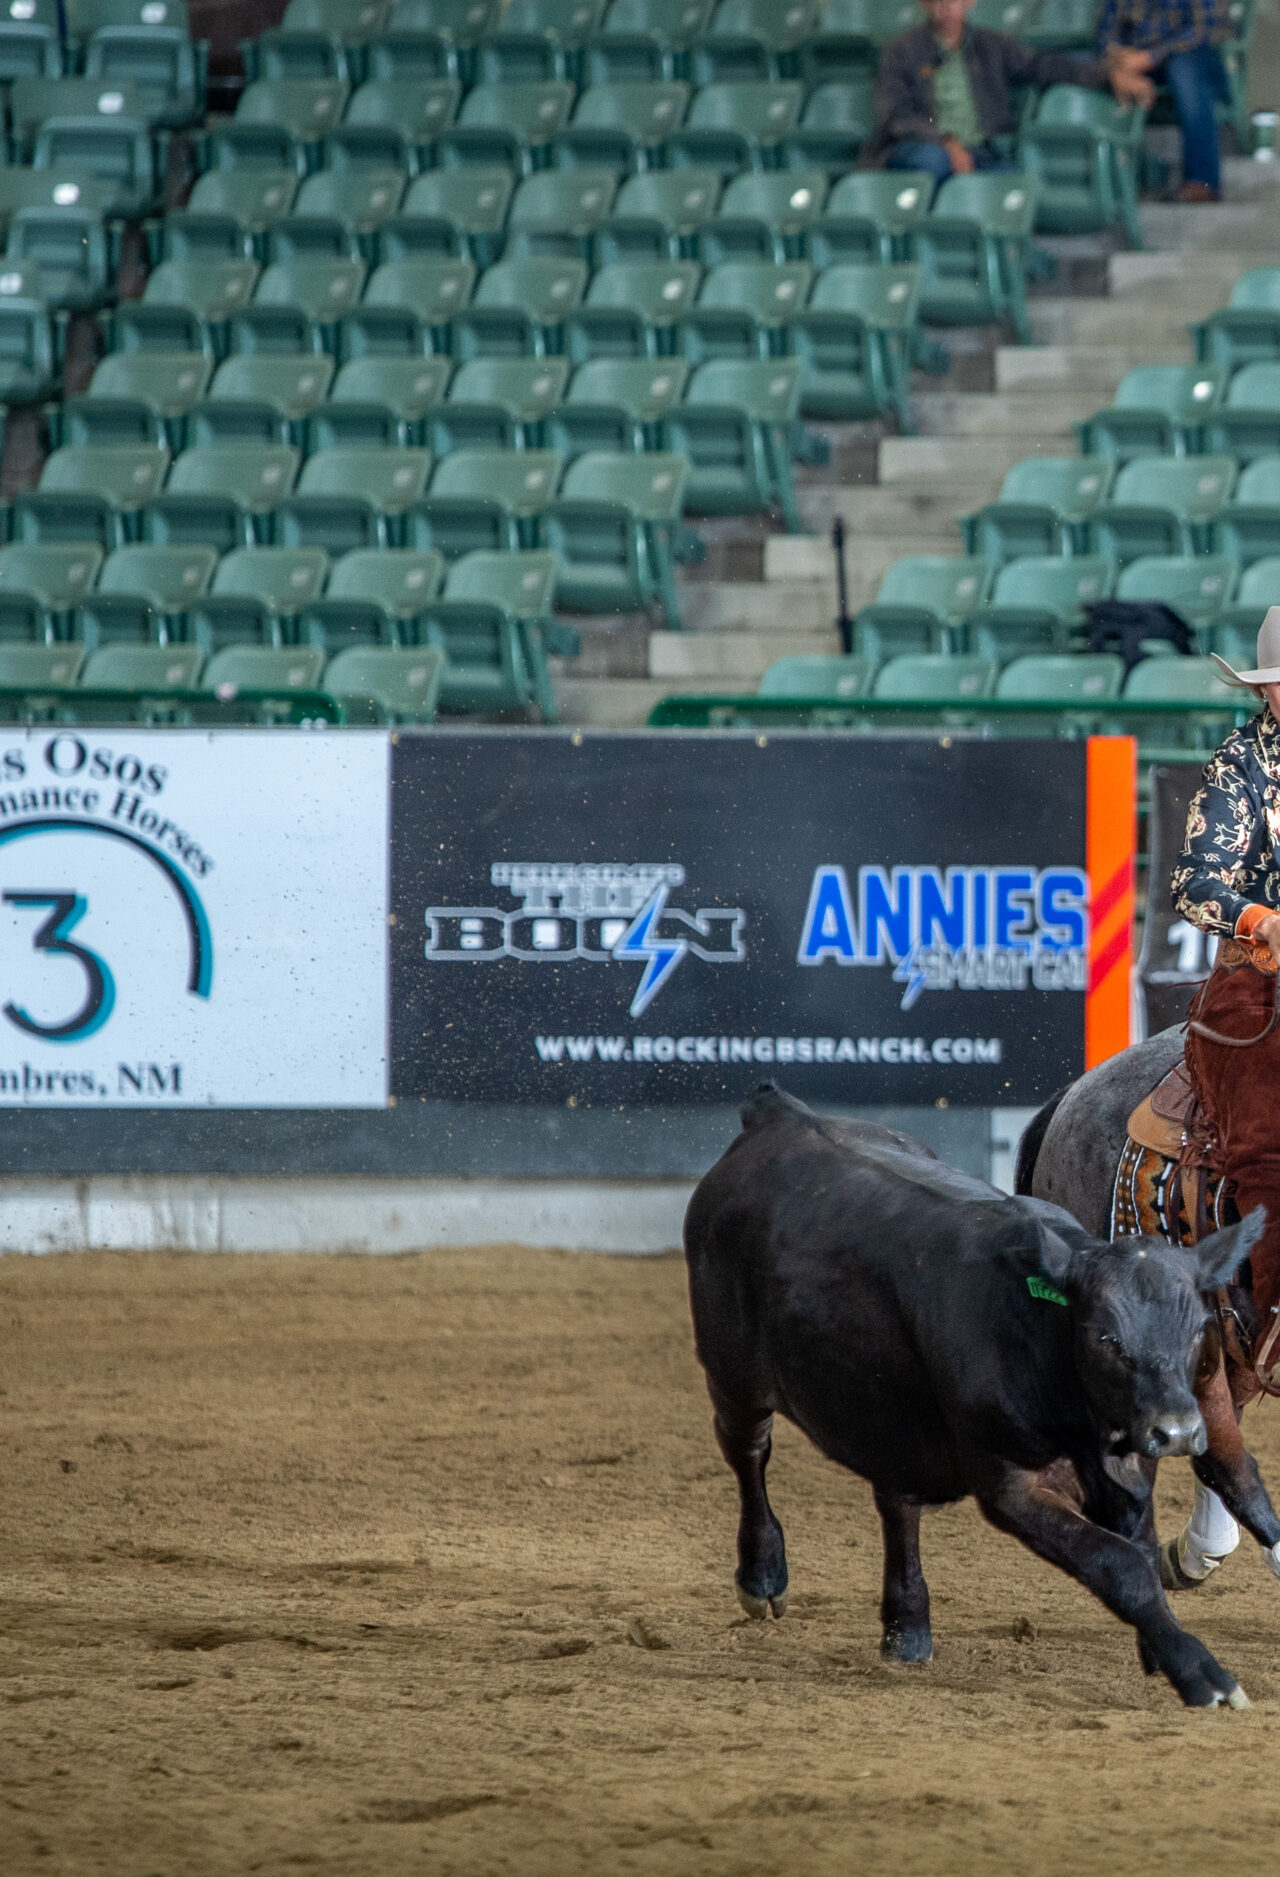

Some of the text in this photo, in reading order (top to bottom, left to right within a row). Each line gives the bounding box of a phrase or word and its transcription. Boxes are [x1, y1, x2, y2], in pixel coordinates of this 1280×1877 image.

[44, 731, 168, 796] Osos
[110, 788, 215, 879] Horses
[797, 865, 1088, 966] ANNIES
[118, 1062, 181, 1095] NM
